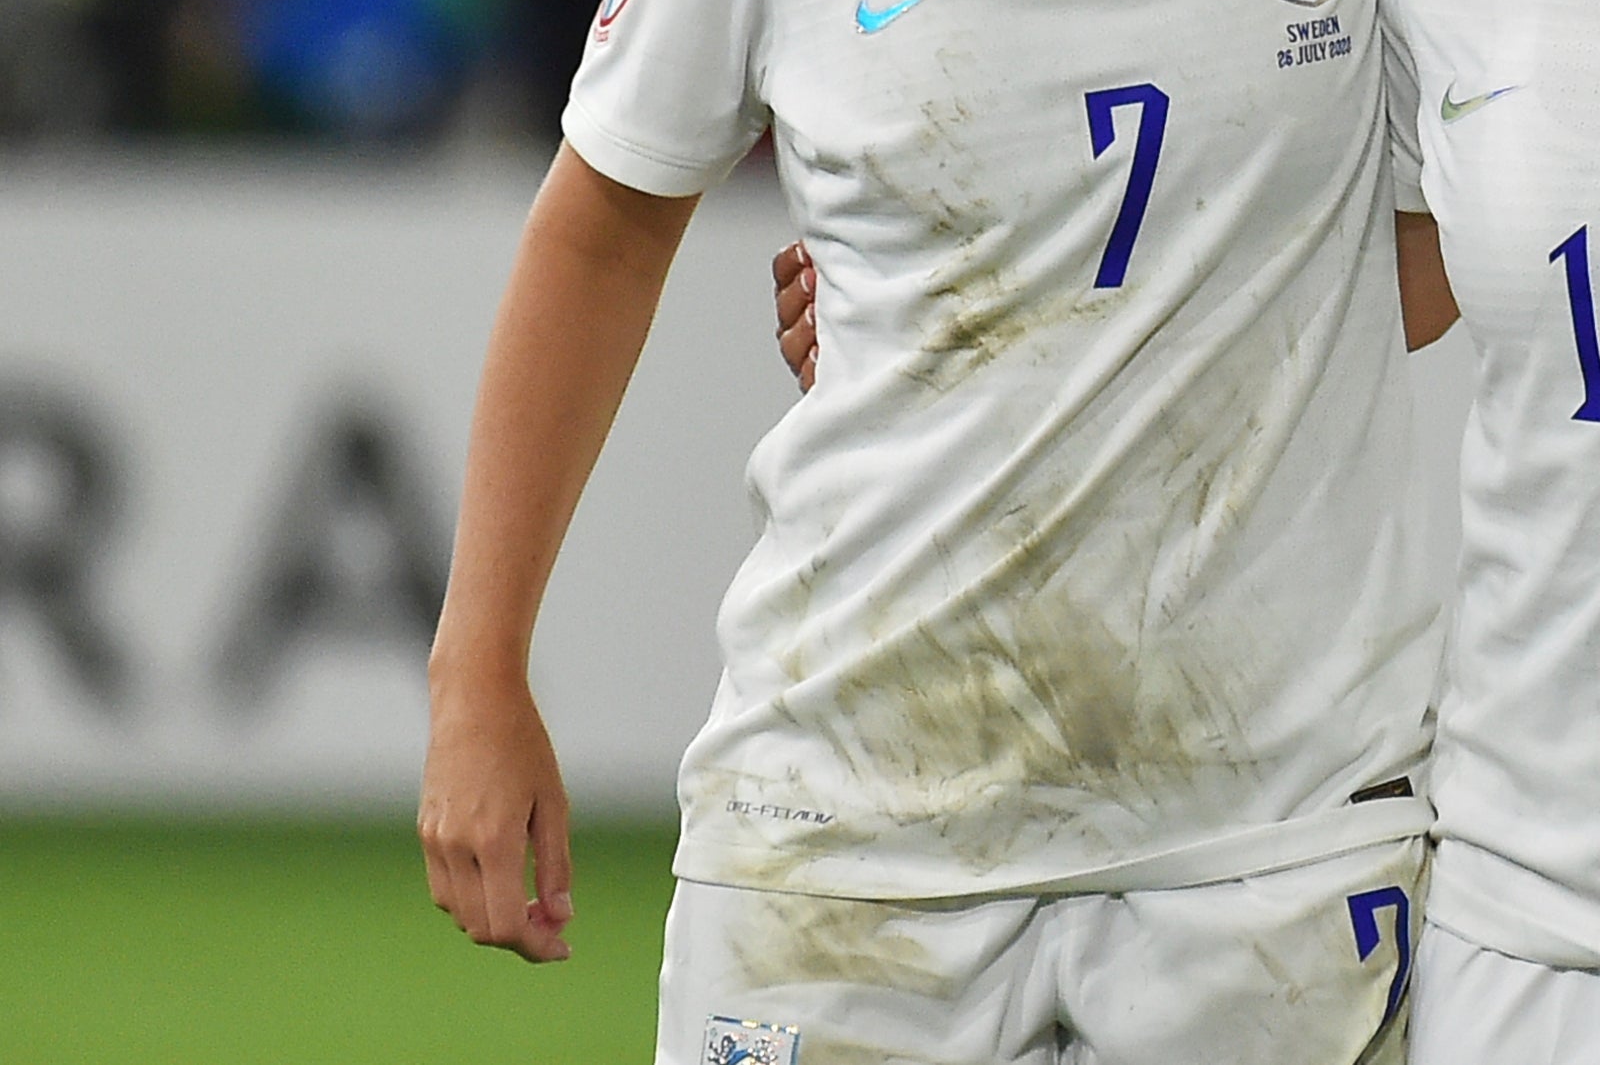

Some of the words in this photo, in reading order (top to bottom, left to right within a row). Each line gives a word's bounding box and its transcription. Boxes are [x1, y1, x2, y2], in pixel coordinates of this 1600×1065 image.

[1286, 15, 1340, 43] SWEDEN
[1277, 49, 1293, 68] 26
[1296, 41, 1326, 66] JULY
[1084, 83, 1170, 289] 7
